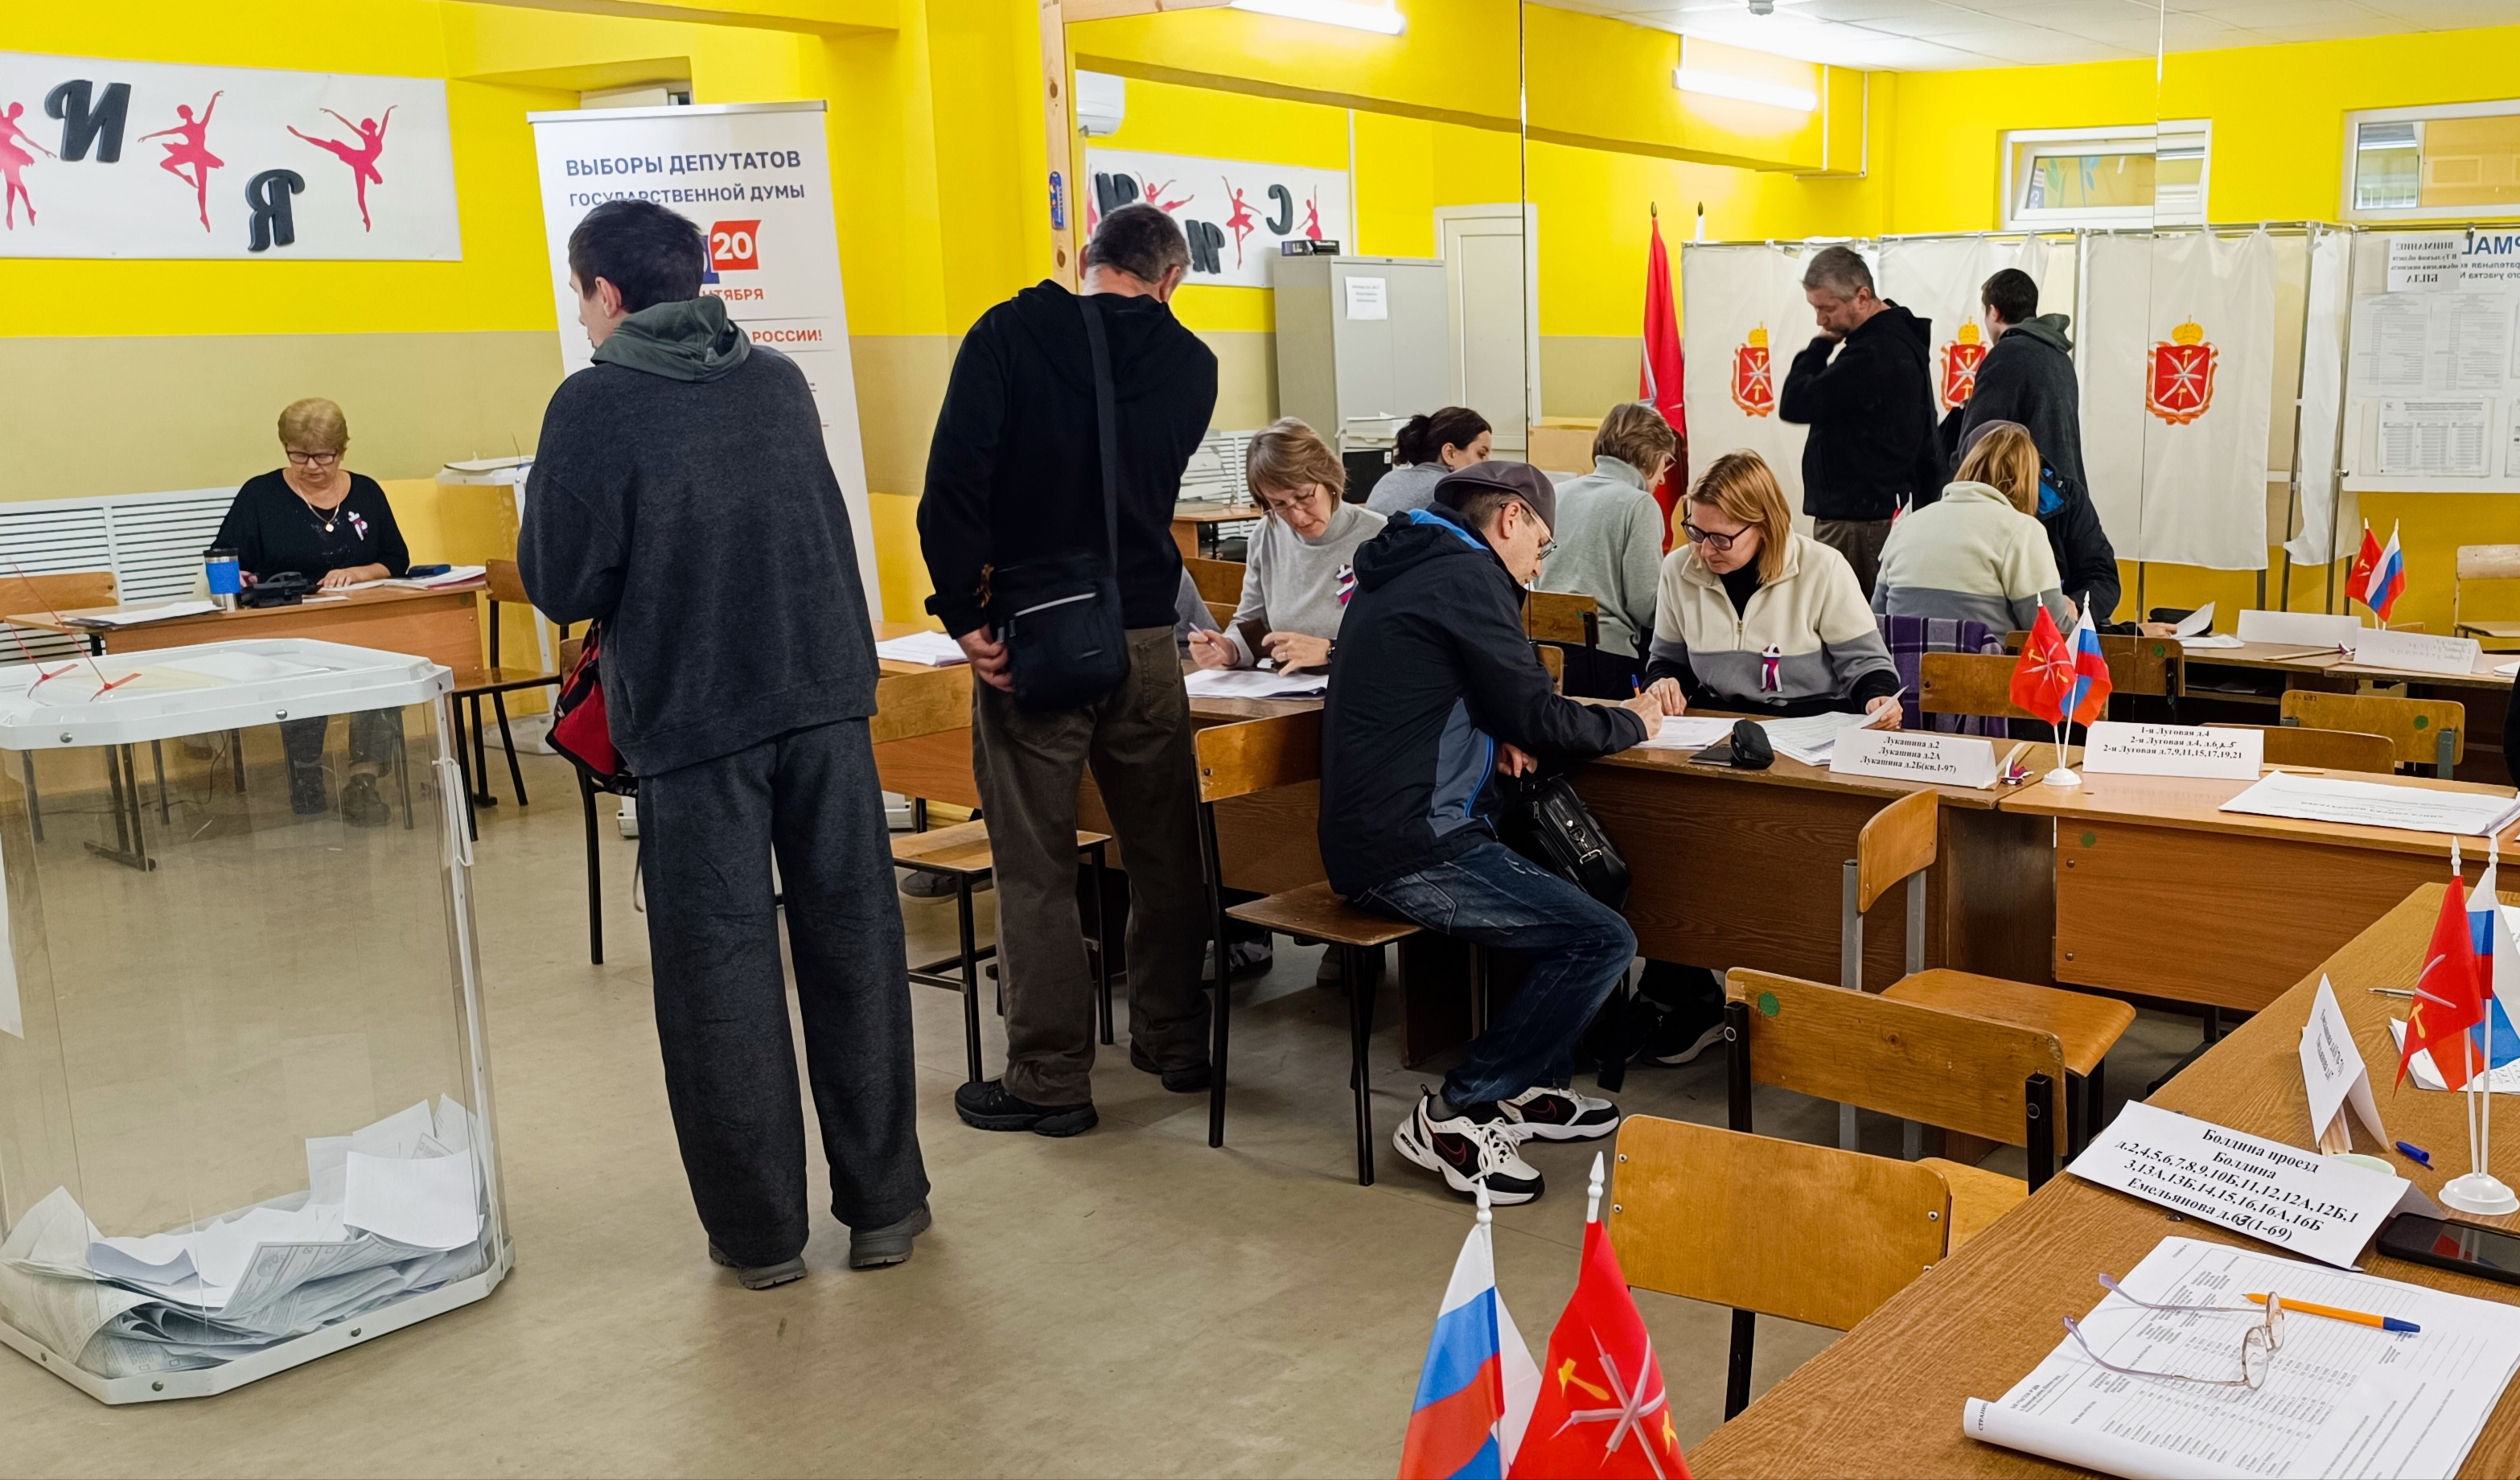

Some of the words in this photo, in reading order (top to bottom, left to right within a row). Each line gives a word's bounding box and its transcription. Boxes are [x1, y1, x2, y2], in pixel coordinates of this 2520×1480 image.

[566, 156, 663, 176] ВЫБОРЫ
[669, 150, 801, 175] ДЕПУТАТОВ
[750, 184, 805, 202] ДУМЫ
[245, 168, 306, 252] Я
[713, 232, 753, 261] 20
[702, 288, 764, 301] ТЯБРЯ
[752, 329, 823, 343] РОССИИ!
[2140, 726, 2154, 734] 1-я
[2156, 727, 2194, 737] Луговая
[1883, 736, 1926, 748] Лукашина
[1928, 741, 1940, 749] д.2
[2146, 737, 2185, 746] Луговая
[1878, 746, 1922, 758] Лукашина
[1922, 752, 1941, 760] д.2А
[2103, 744, 2117, 752] 2-я
[2119, 745, 2157, 754] Луговая
[2158, 748, 2242, 759] д.7,9,11,15,17,19,21
[1860, 755, 1902, 767] Лукашина
[1904, 761, 1957, 774] д.2Б(кв.1-97)
[2202, 1128, 2265, 1157] Болдина
[2267, 1150, 2320, 1174] проезд
[2212, 1151, 2276, 1179] Болдина
[2127, 1178, 2216, 1215] Емельянова
